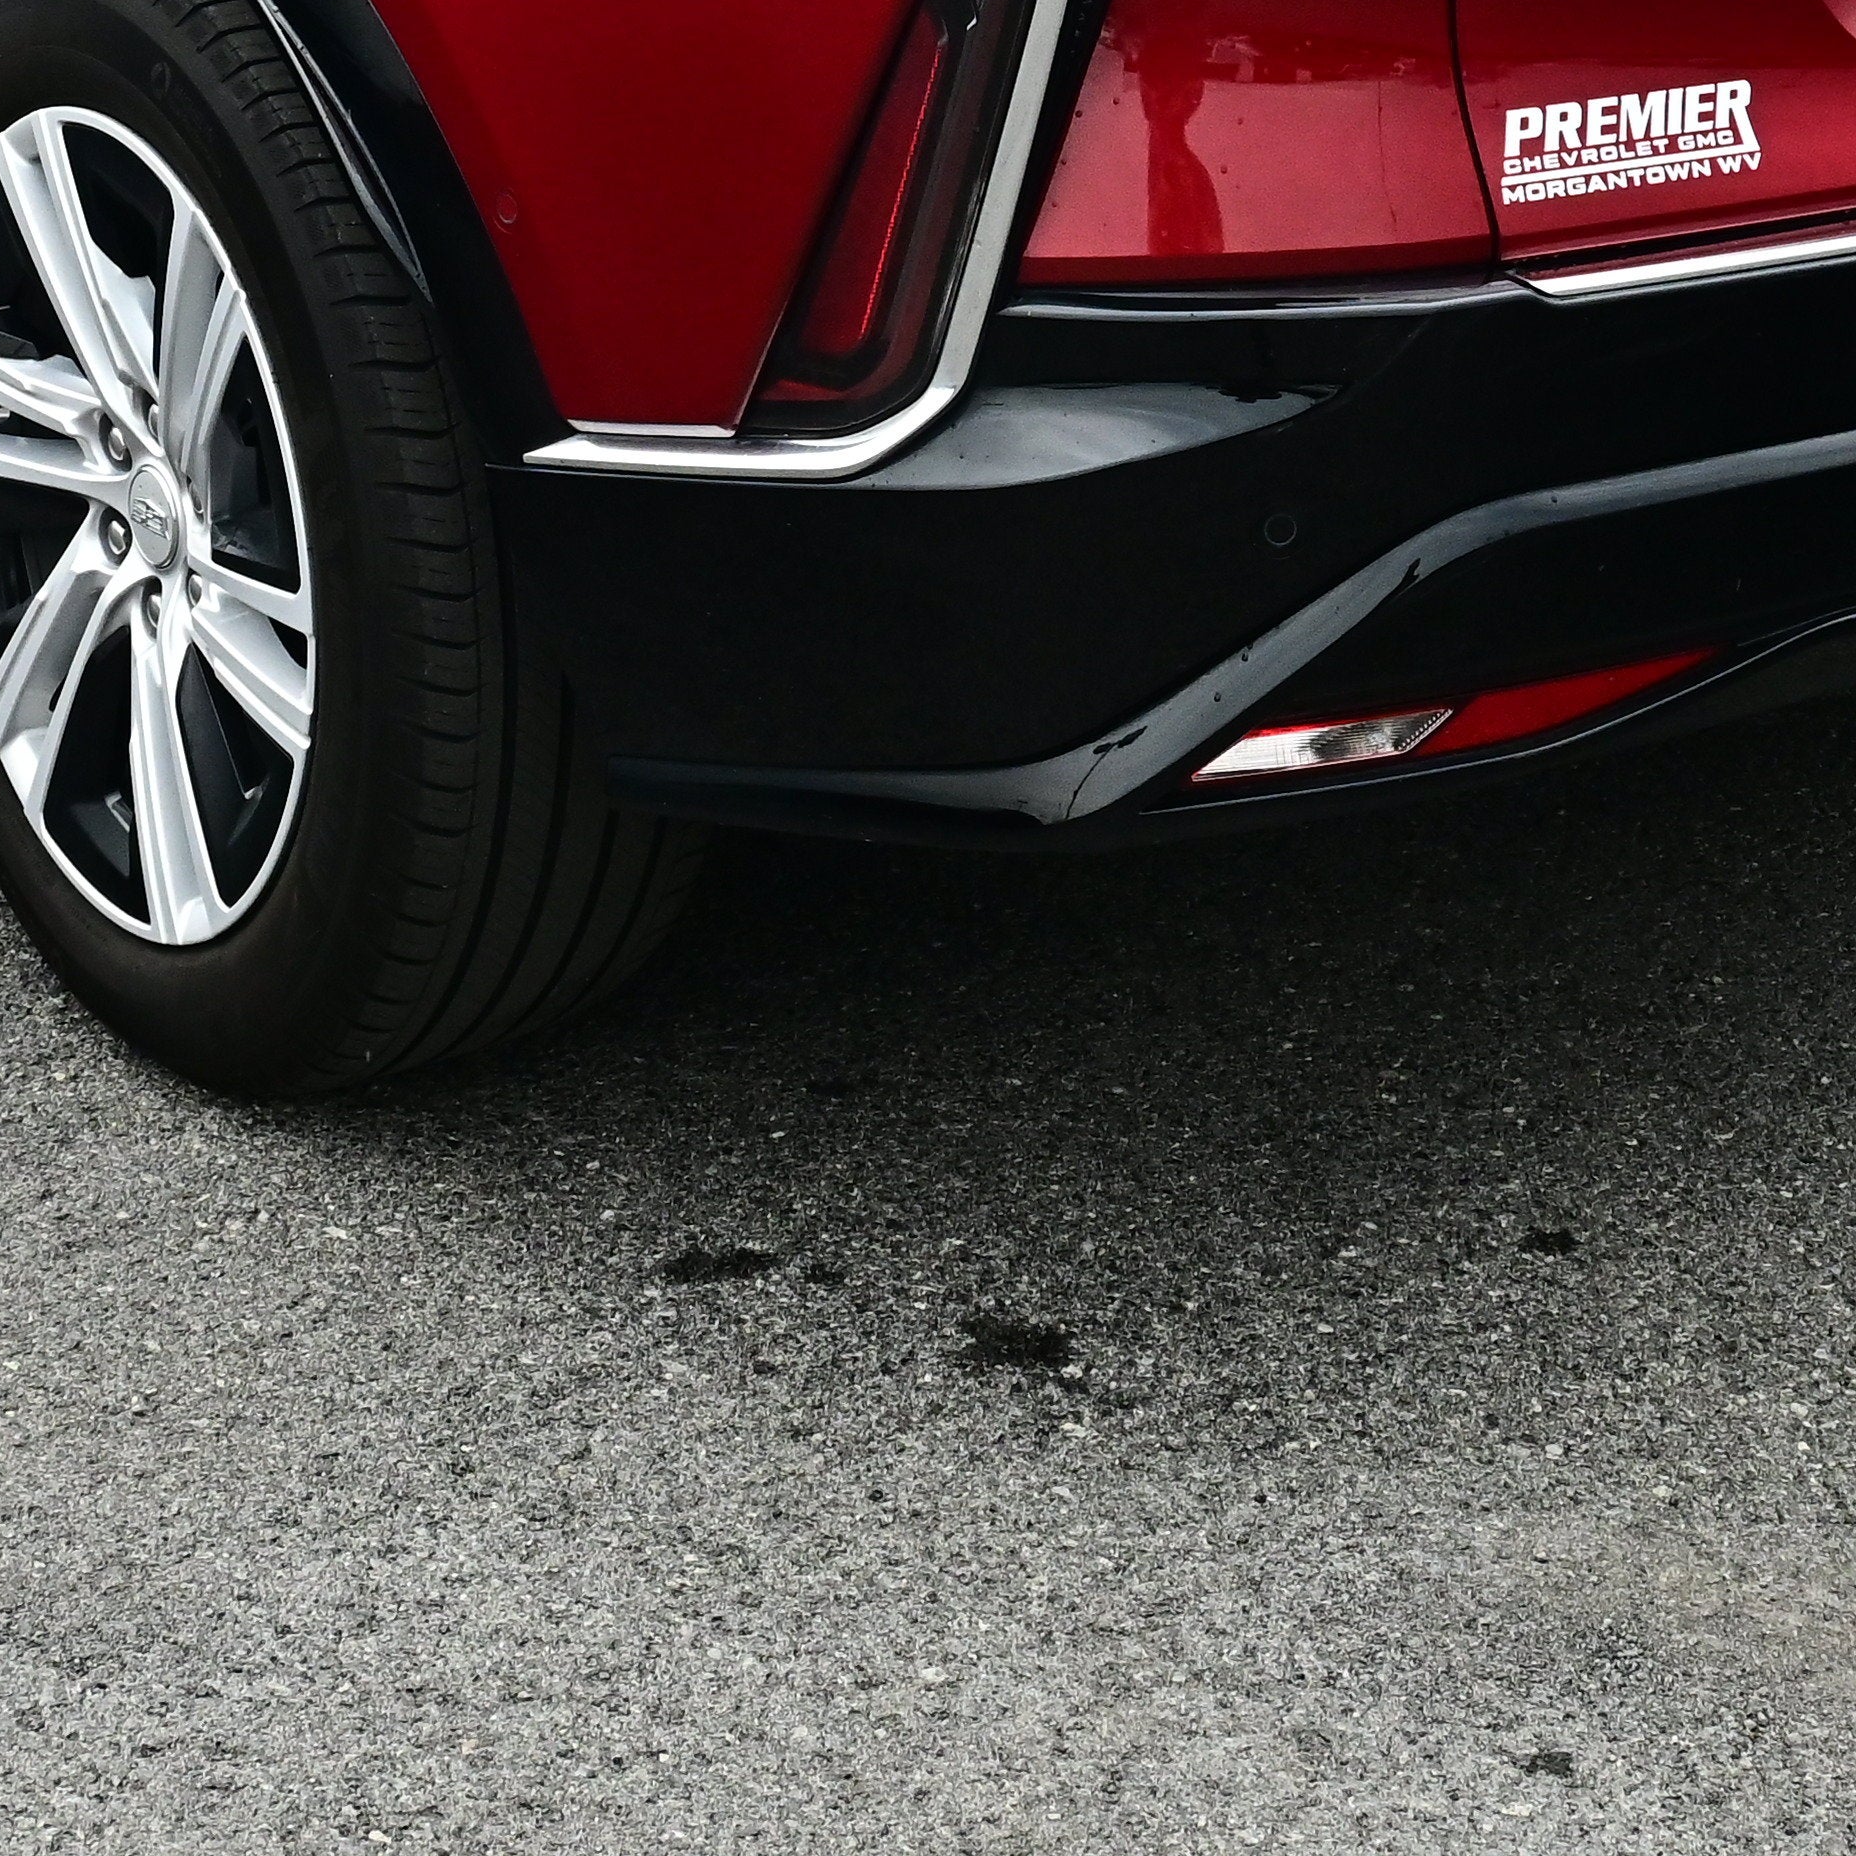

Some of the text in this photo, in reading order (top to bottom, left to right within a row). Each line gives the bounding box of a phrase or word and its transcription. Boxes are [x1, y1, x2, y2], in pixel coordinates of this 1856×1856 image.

[1504, 79, 1761, 158] PREMIER
[1501, 152, 1762, 205] MORGANTOWN WV
[1503, 129, 1734, 175] CHEVROLET GMC
